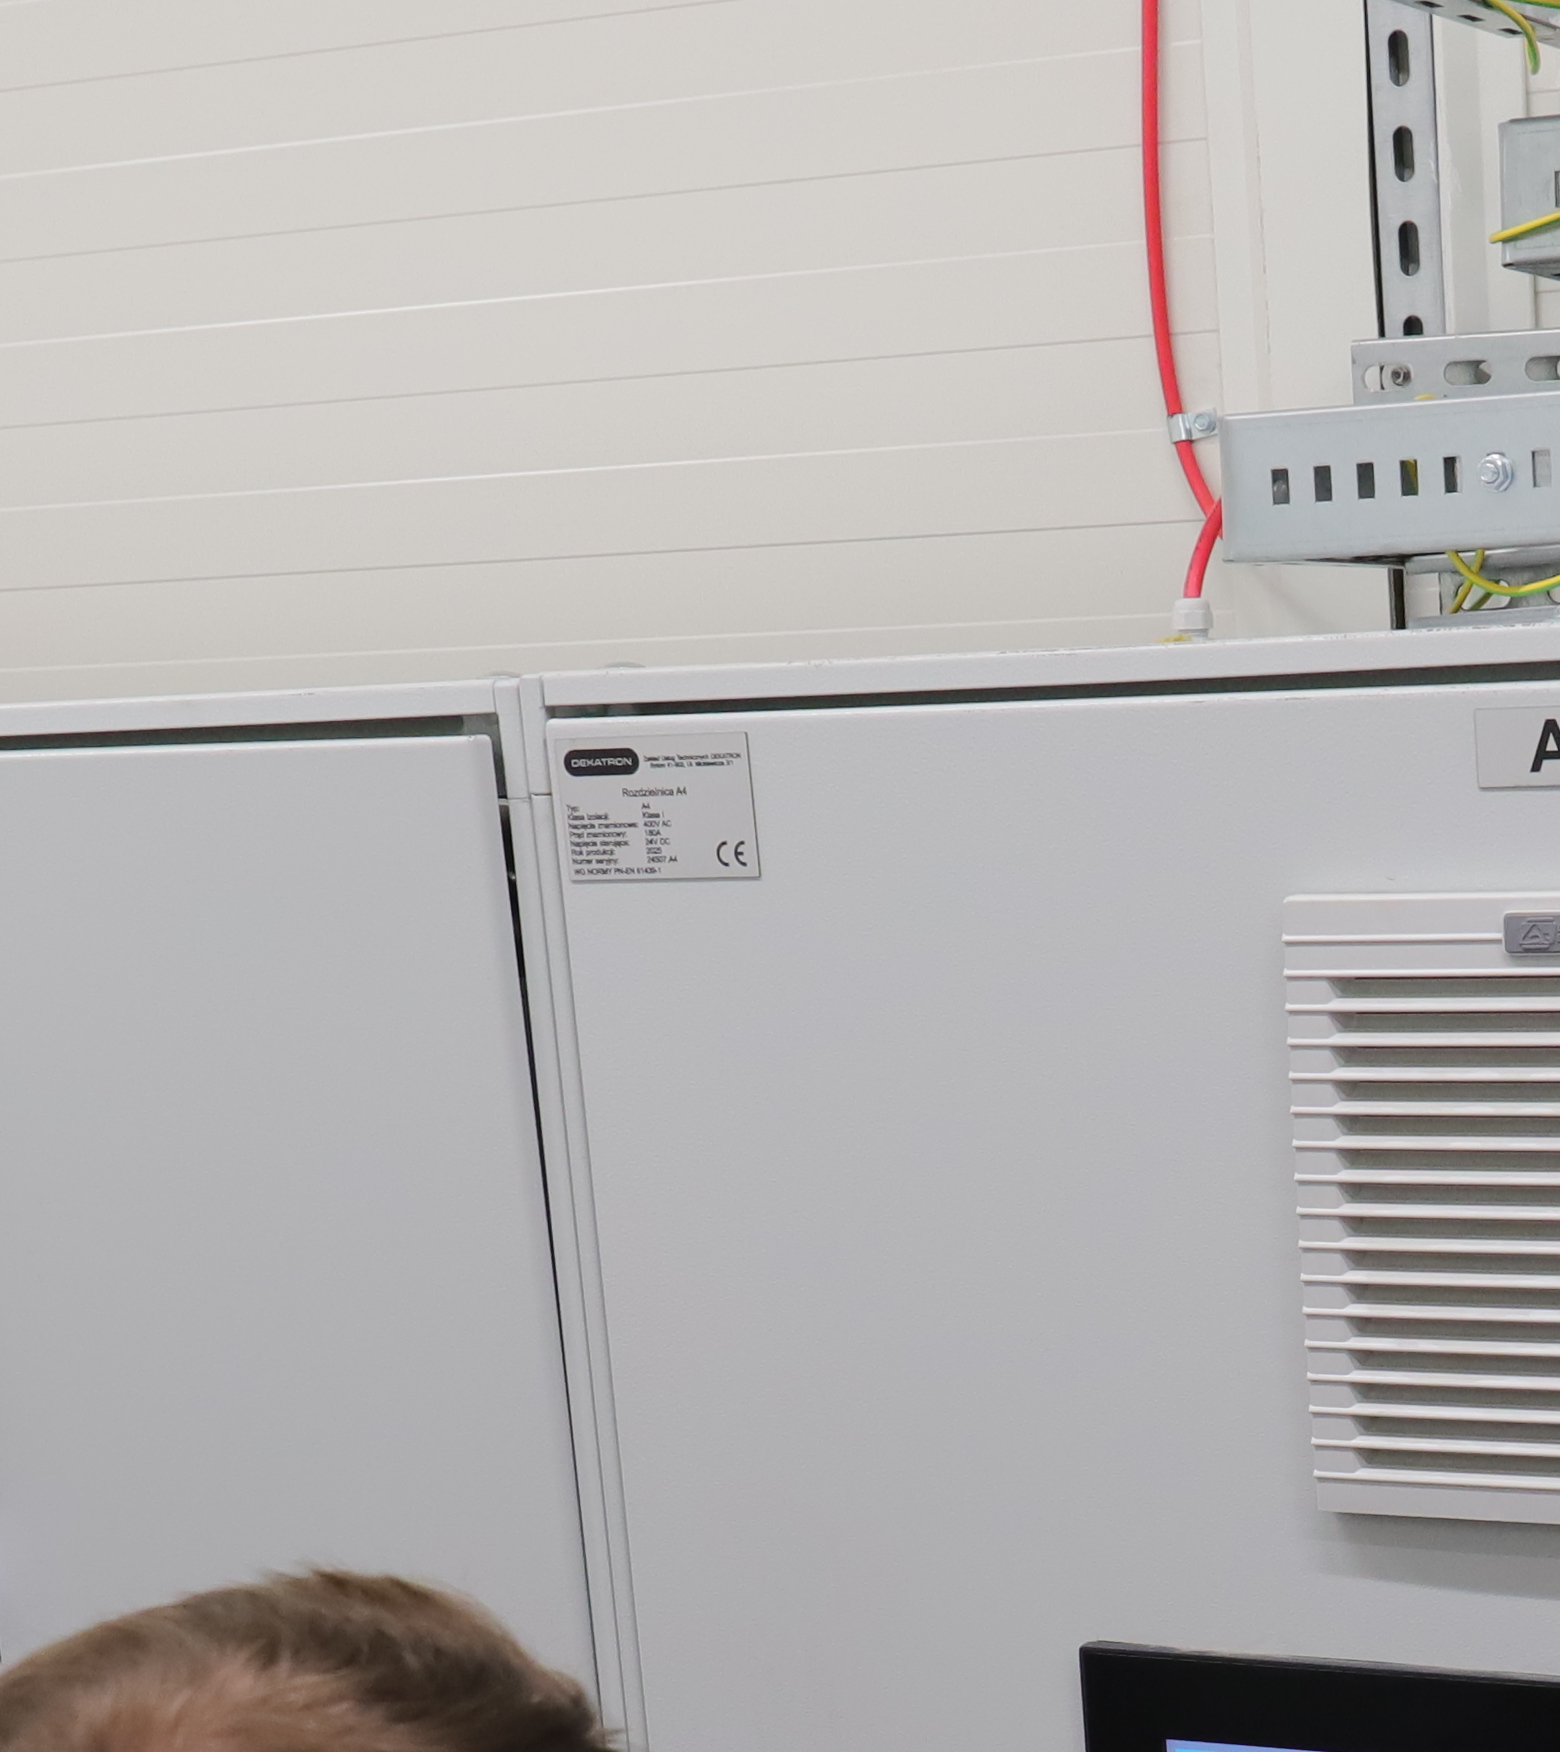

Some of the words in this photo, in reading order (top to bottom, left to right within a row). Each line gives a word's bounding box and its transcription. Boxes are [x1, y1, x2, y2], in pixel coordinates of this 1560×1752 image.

[622, 788, 675, 797] Rozdzielnica
[676, 787, 687, 796] A4
[716, 841, 747, 867] CE
